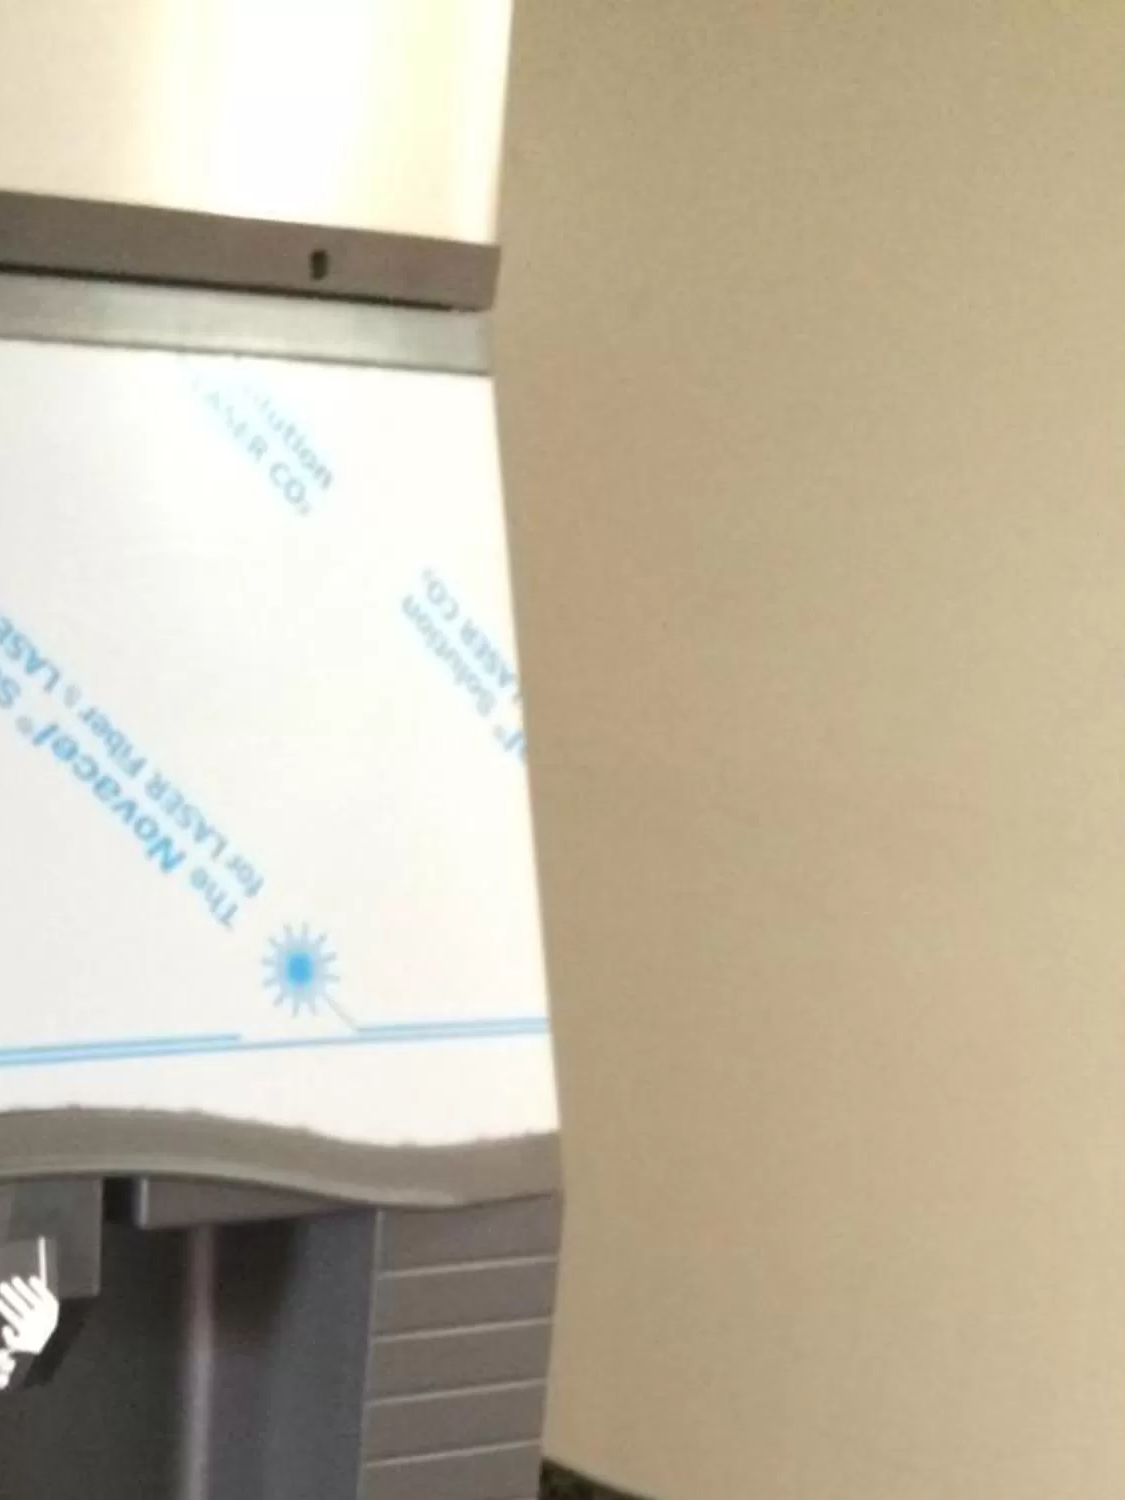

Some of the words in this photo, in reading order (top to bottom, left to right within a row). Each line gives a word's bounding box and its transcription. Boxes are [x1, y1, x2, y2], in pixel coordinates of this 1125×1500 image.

[78, 704, 148, 780] Fiber
[144, 769, 228, 861] LASER
[190, 866, 239, 932] The
[224, 852, 265, 899] for
